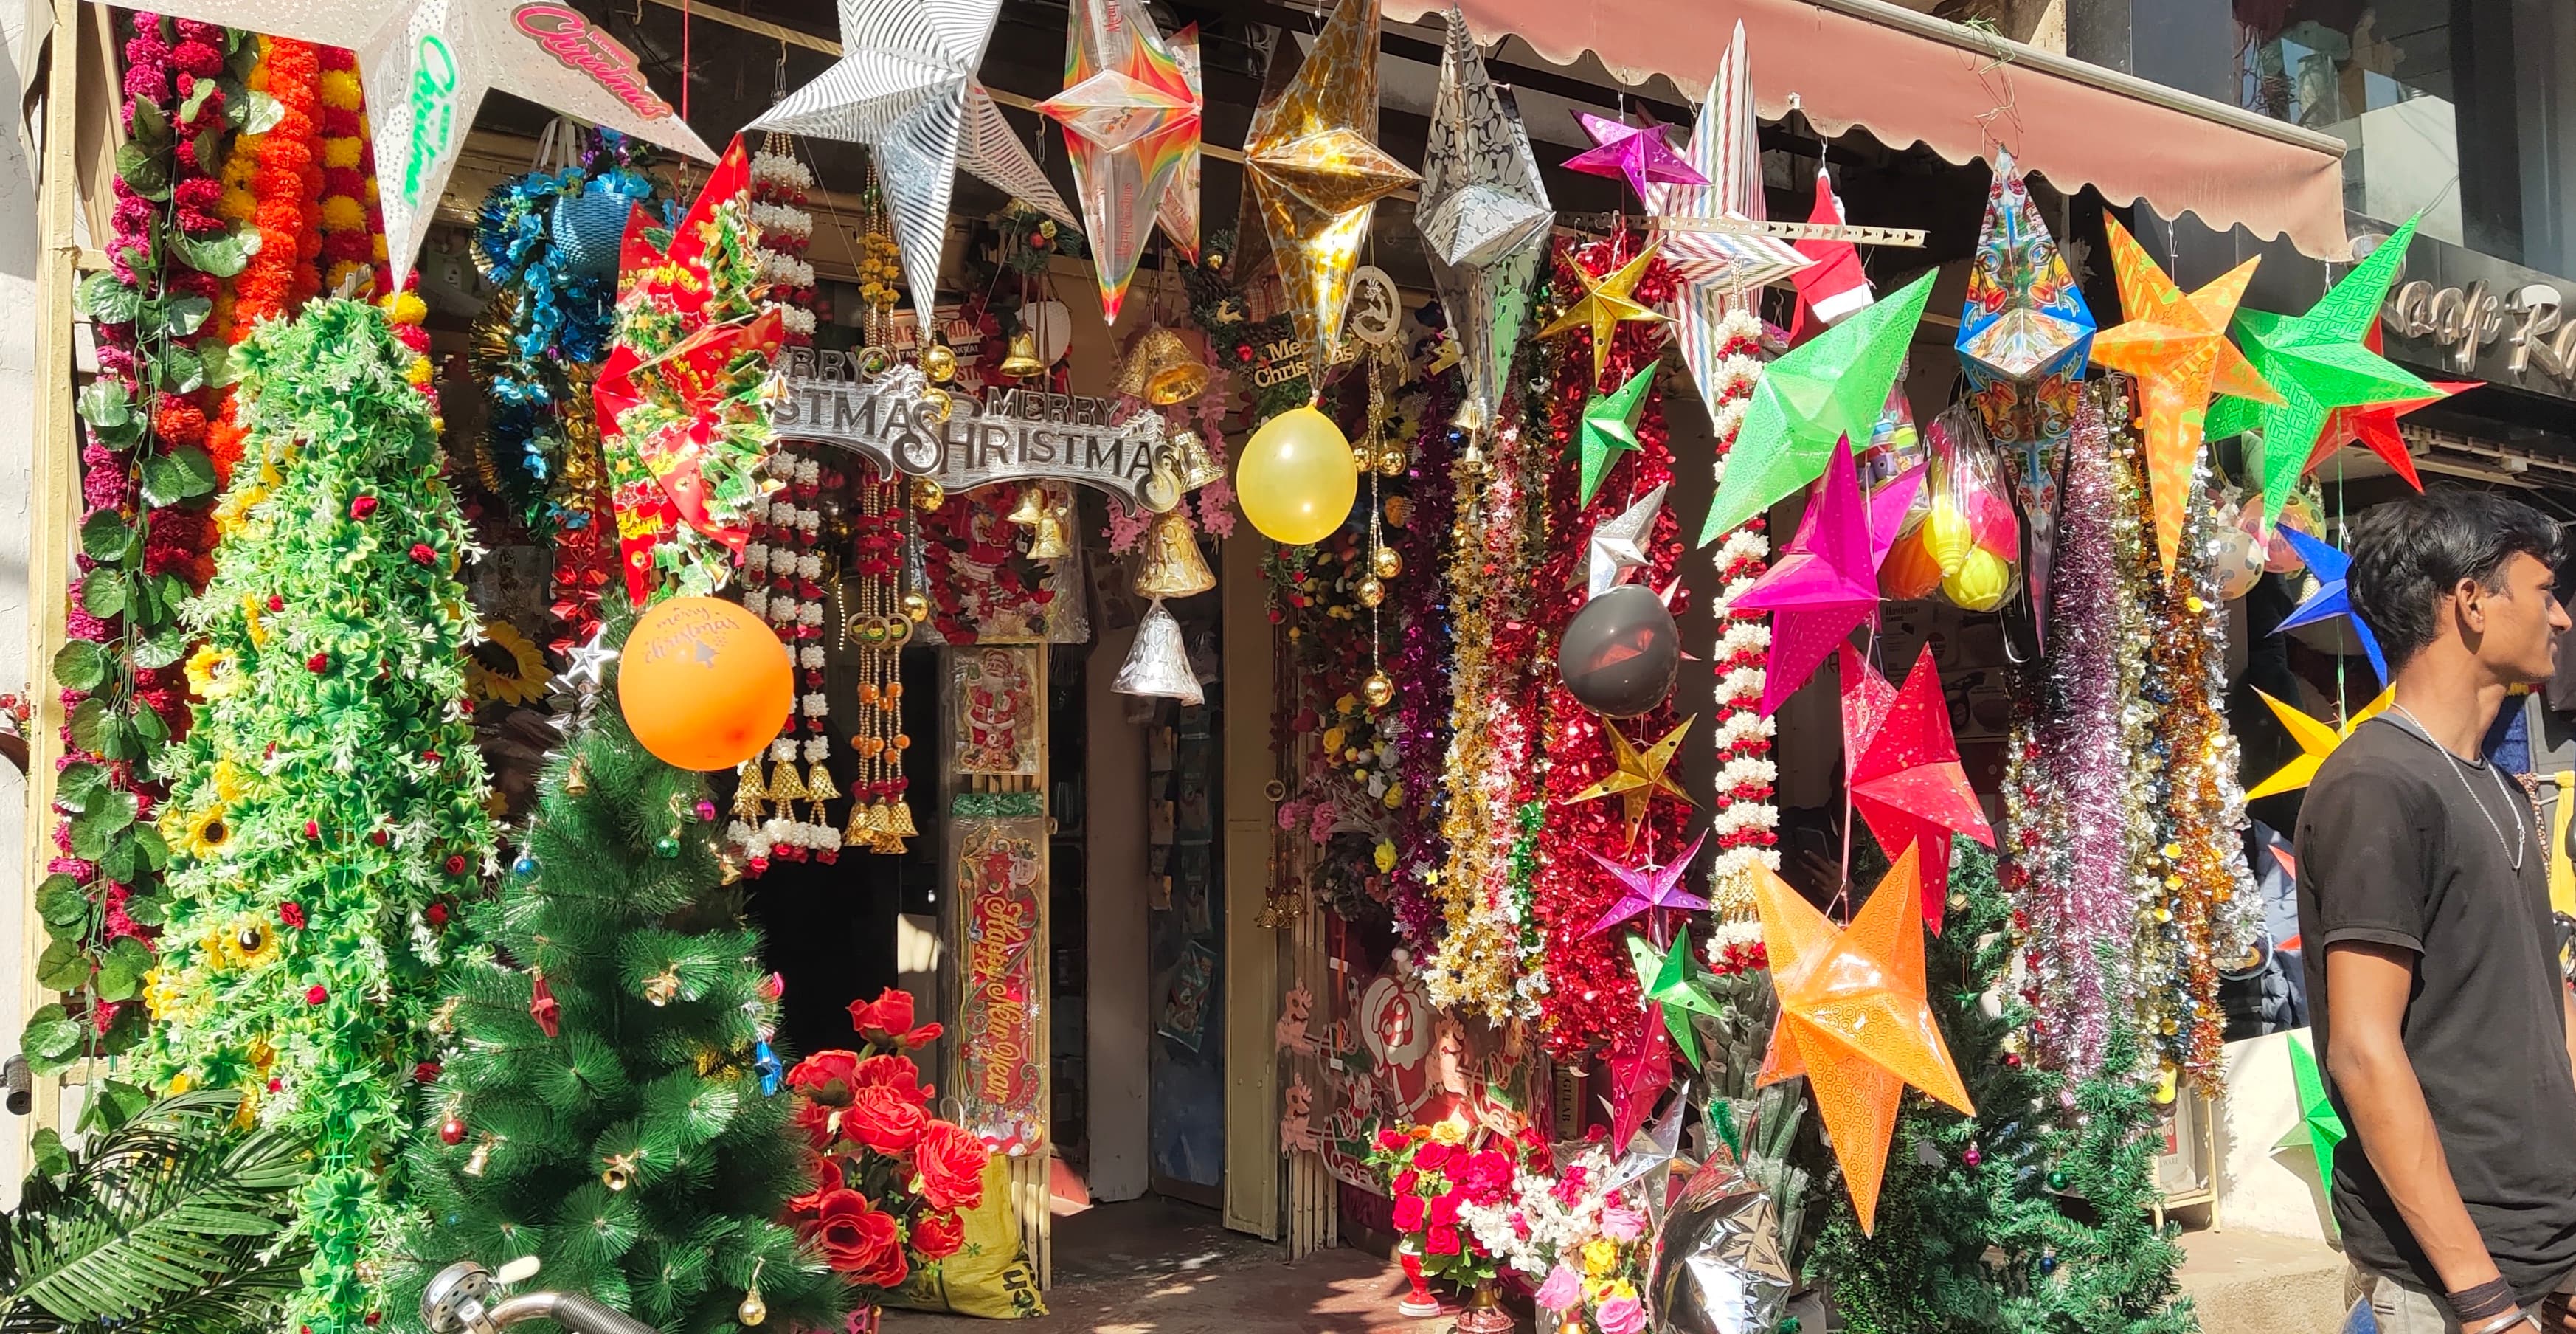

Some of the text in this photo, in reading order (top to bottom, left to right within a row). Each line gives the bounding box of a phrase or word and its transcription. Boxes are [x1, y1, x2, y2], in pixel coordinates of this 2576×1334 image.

[515, 5, 668, 117] Christmas
[403, 35, 455, 209] Christmas
[782, 345, 874, 386] RRY
[775, 387, 944, 476] STMAS
[987, 386, 1121, 429] MERRY
[645, 615, 740, 663] christmas
[657, 607, 710, 629] merry
[973, 896, 1025, 1104] Happy New Year
